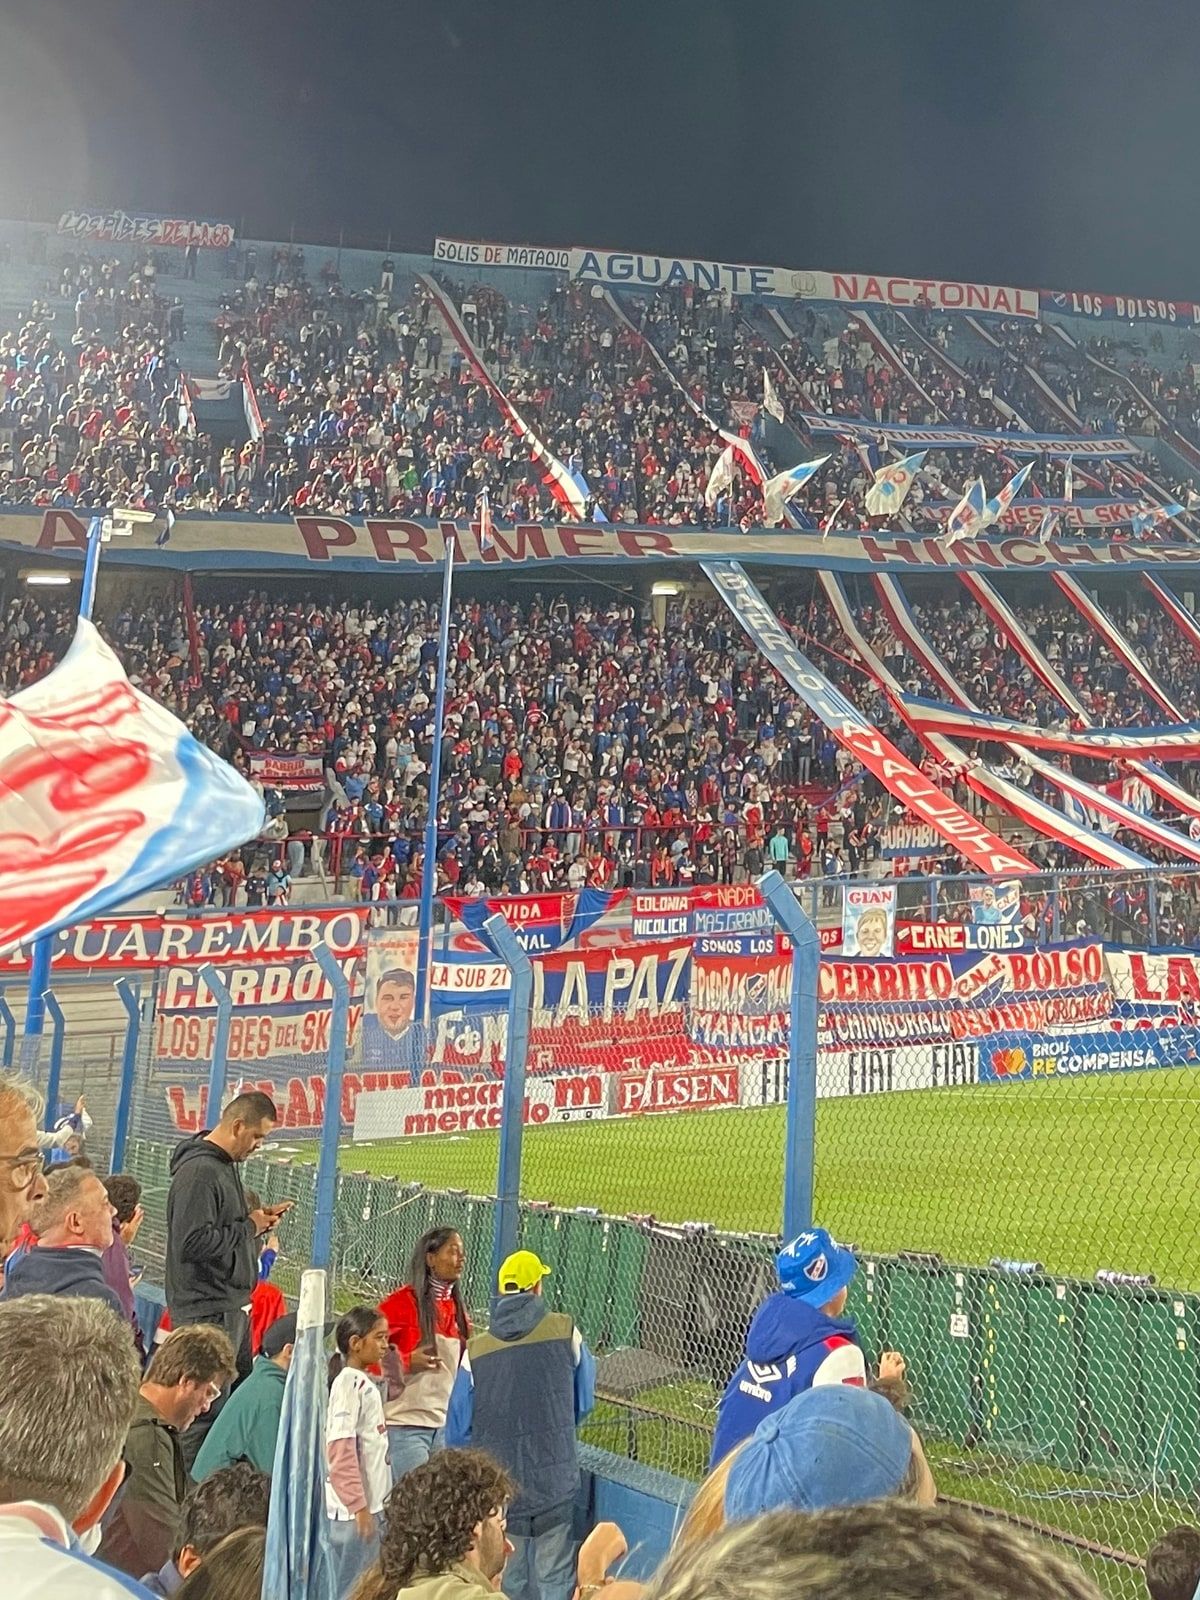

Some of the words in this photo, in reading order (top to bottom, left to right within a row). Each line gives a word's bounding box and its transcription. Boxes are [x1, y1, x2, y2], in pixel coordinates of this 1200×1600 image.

[438, 242, 479, 262] SOLIS
[484, 247, 501, 262] DE
[507, 248, 569, 267] MATAOJO
[579, 252, 775, 293] AGUANTE
[1071, 292, 1103, 316] LOS
[1115, 297, 1177, 322] BOLSOS
[295, 514, 683, 565] PRIMER
[637, 896, 688, 912] COLONIA
[718, 887, 756, 907] NADA
[849, 889, 892, 904] GIAN
[500, 903, 542, 920] VIDA
[634, 917, 687, 936] NICOLICH
[911, 923, 1025, 949] CANELONES
[702, 939, 742, 954] SOMOS
[750, 938, 774, 954] LOS
[431, 967, 447, 986] LA
[454, 967, 486, 988] SUB
[489, 965, 508, 986] 21
[1010, 944, 1102, 990] BOLSO
[818, 961, 953, 1001] CERRITO
[157, 1013, 201, 1058] LOS
[275, 1024, 299, 1047] DEL
[1032, 1043, 1071, 1057] BROU
[622, 1070, 732, 1111] PILSEN
